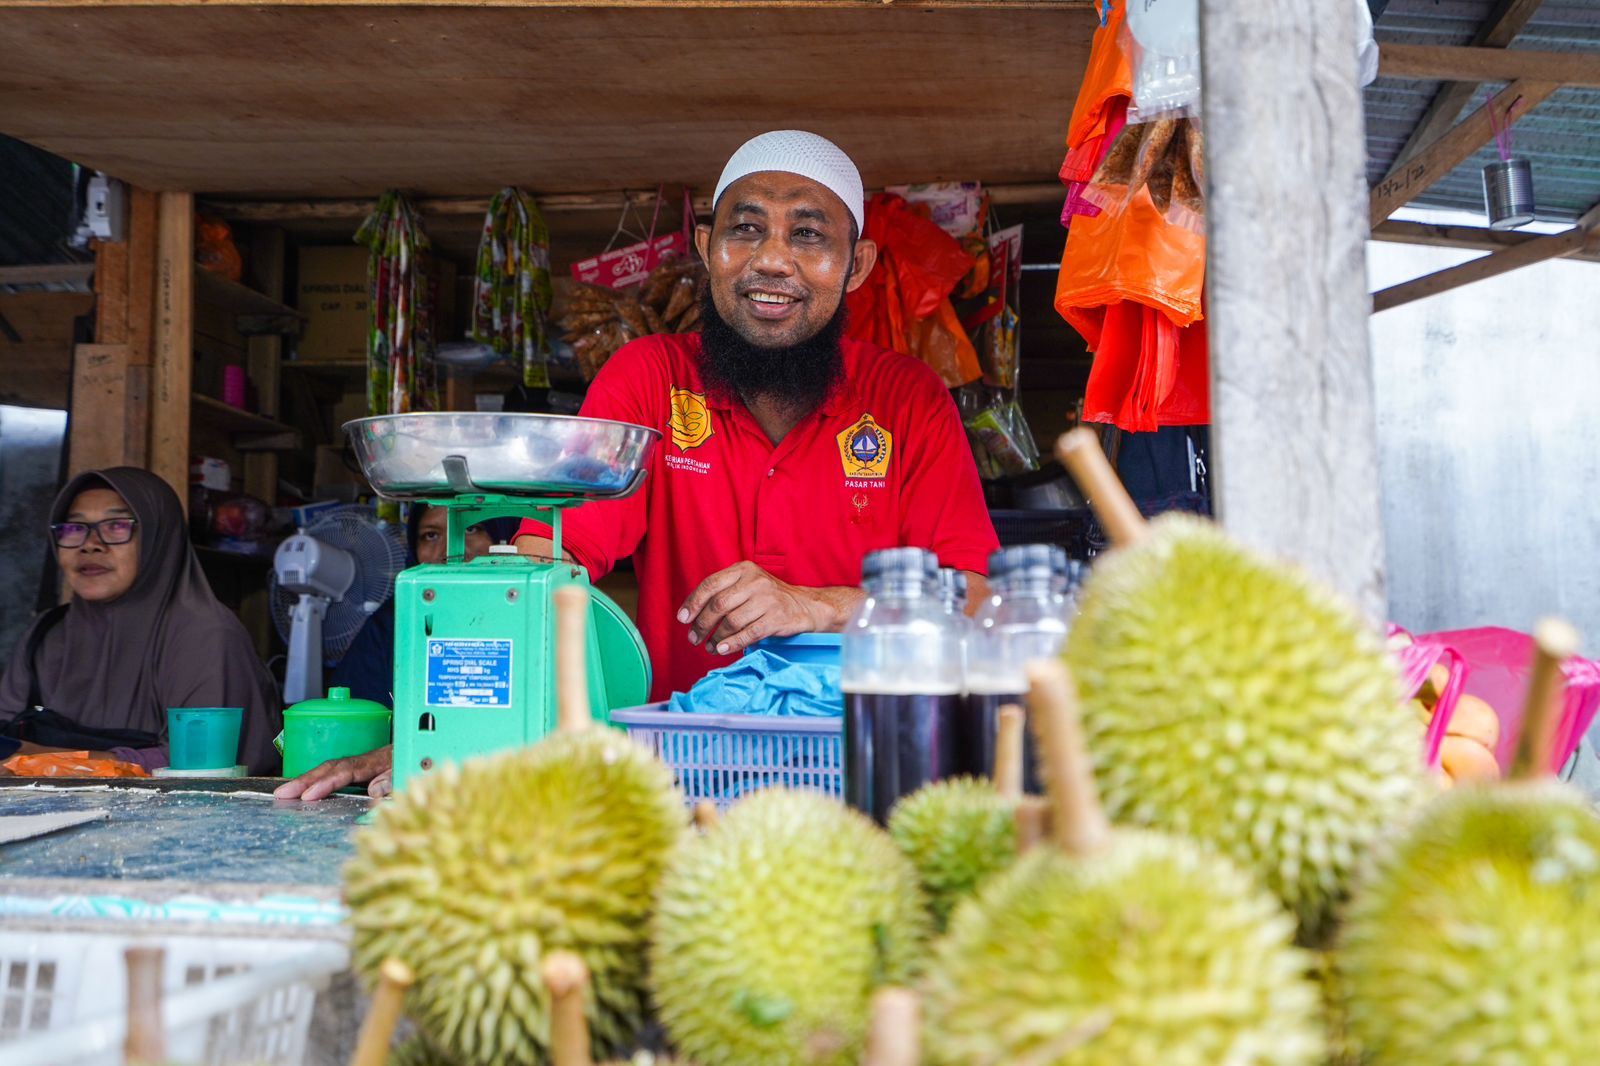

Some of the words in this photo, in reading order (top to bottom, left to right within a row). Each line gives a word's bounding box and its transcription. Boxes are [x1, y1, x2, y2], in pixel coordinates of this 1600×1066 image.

[302, 284, 340, 294] SPRING
[684, 457, 711, 469] PERTANIAN
[681, 464, 708, 474] INDONESIA
[845, 480, 868, 488] PASAR
